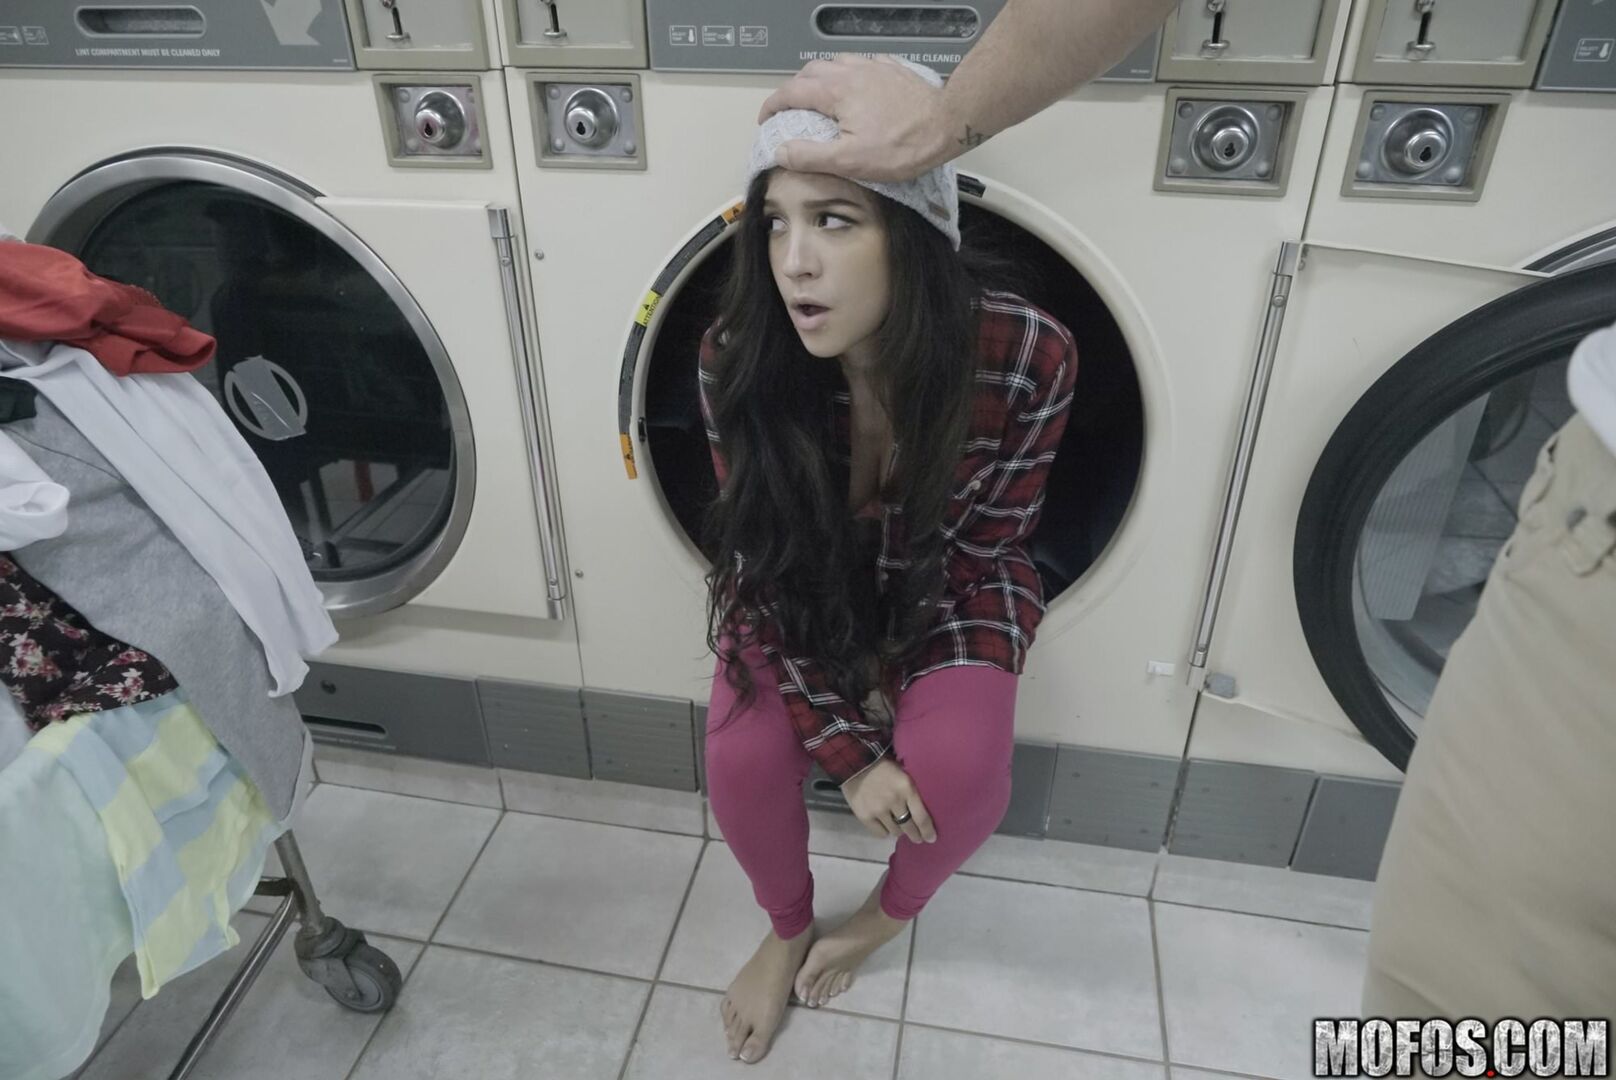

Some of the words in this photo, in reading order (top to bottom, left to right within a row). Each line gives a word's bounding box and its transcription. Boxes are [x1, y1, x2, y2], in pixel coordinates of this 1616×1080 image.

[799, 51, 817, 60] LINT
[910, 53, 921, 62] BE
[922, 53, 961, 63] CLEANED
